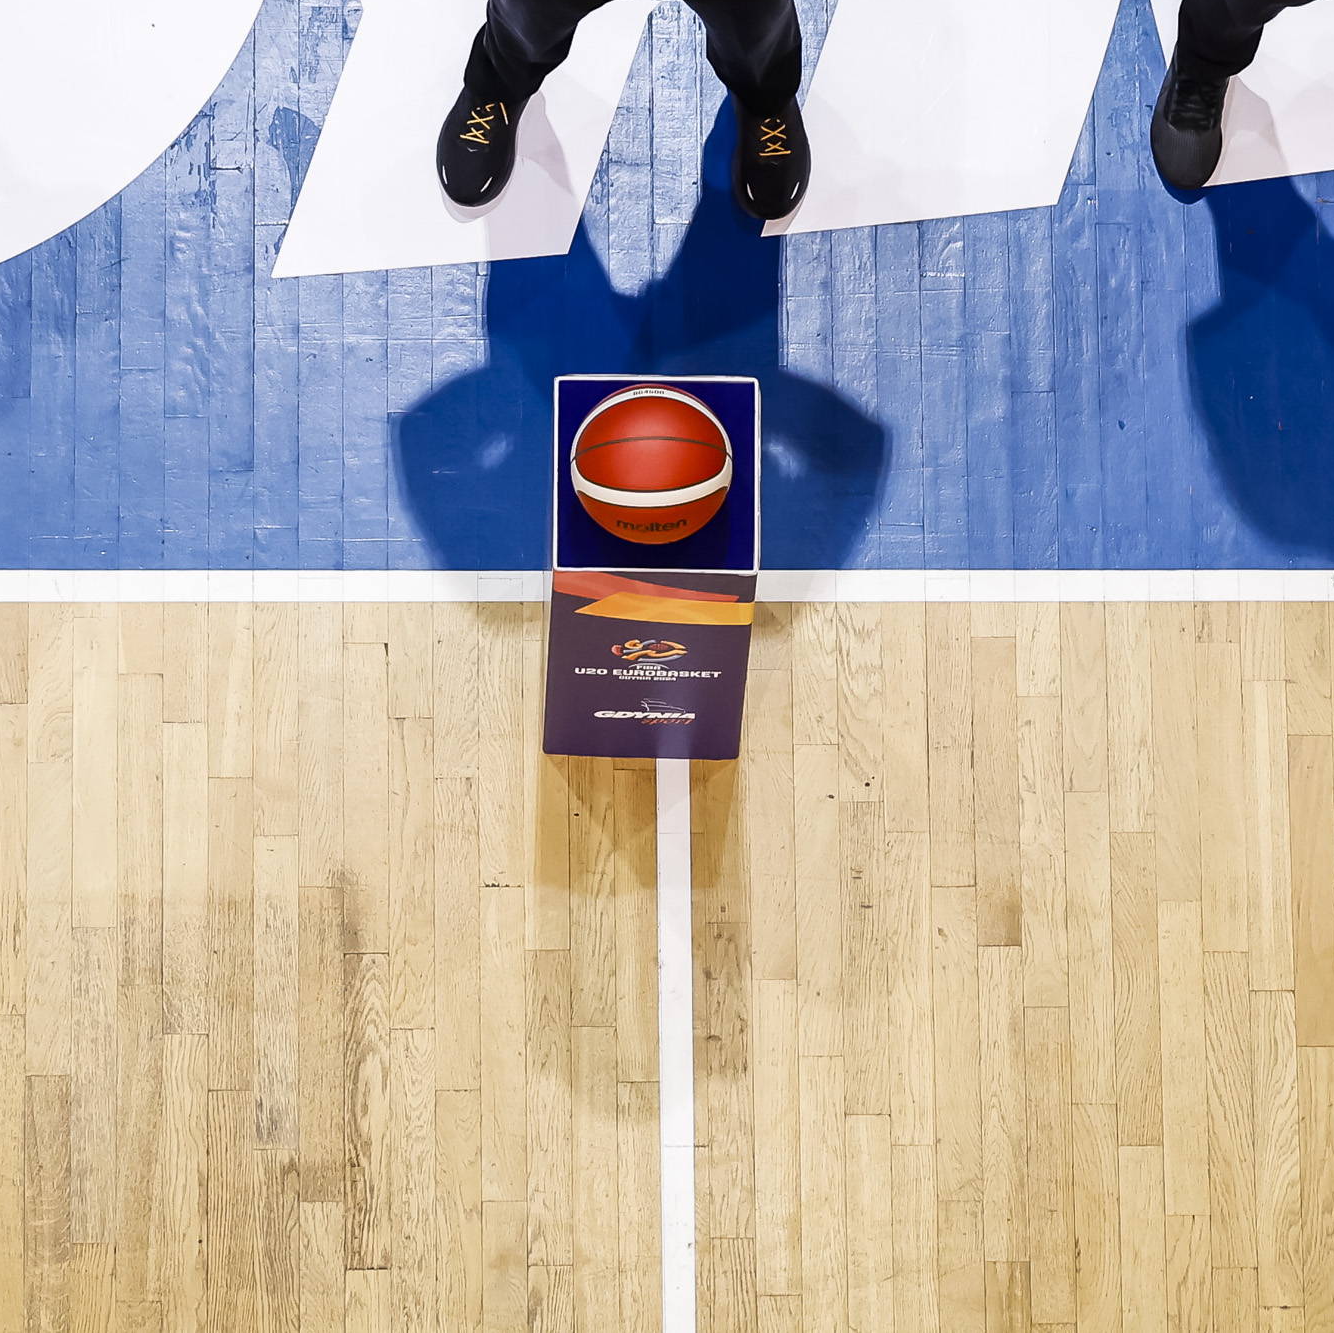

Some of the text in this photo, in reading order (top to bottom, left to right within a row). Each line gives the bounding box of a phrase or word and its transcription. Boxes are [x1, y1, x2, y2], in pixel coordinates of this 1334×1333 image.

[616, 518, 687, 533] molten
[574, 667, 722, 679] U20 EUROBASKET
[593, 710, 696, 719] GDYNIA
[641, 718, 694, 726] sport
